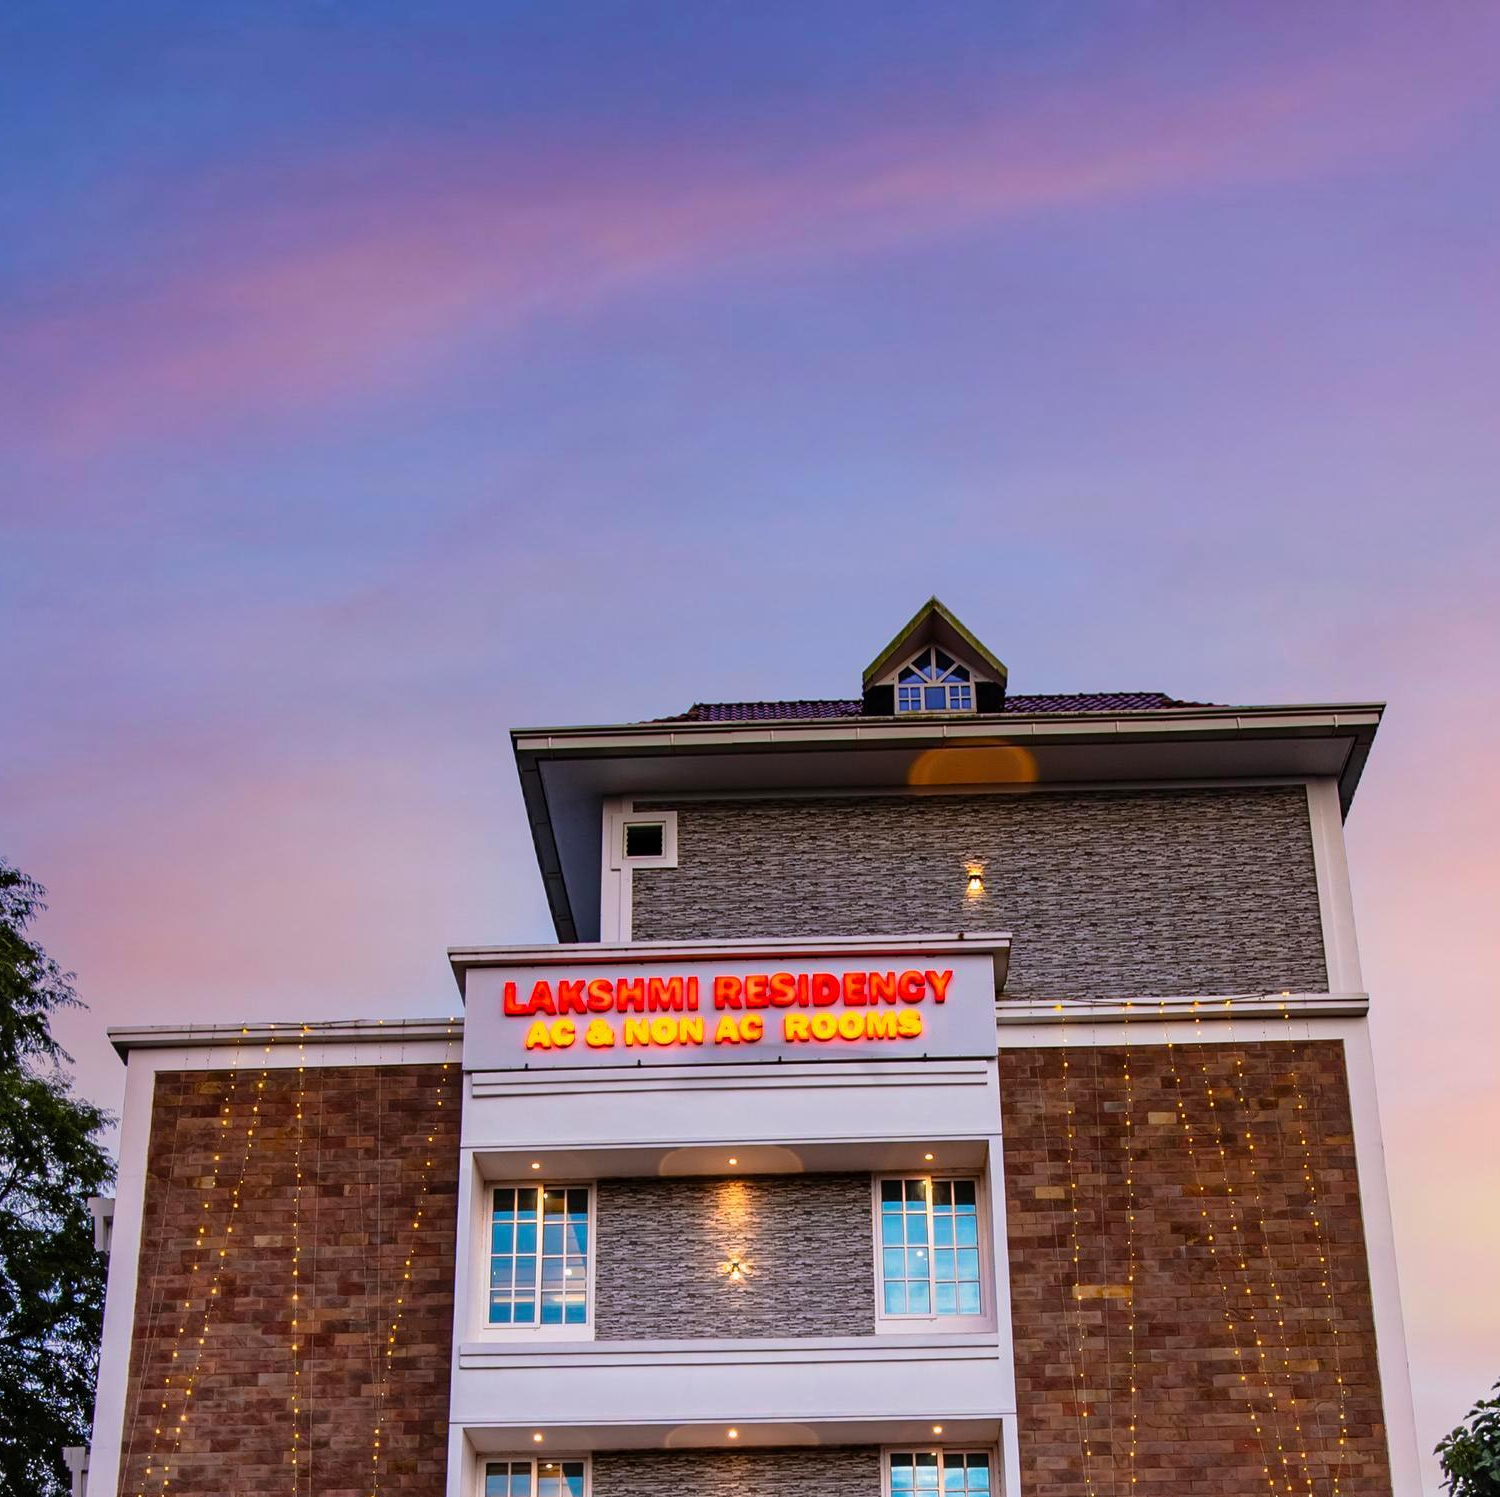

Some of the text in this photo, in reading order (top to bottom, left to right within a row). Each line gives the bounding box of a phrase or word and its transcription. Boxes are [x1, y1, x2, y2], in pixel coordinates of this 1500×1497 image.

[503, 970, 953, 1016] LAKSHMI RESIDENCY
[526, 1008, 923, 1050] AC & NON AC ROOMS
